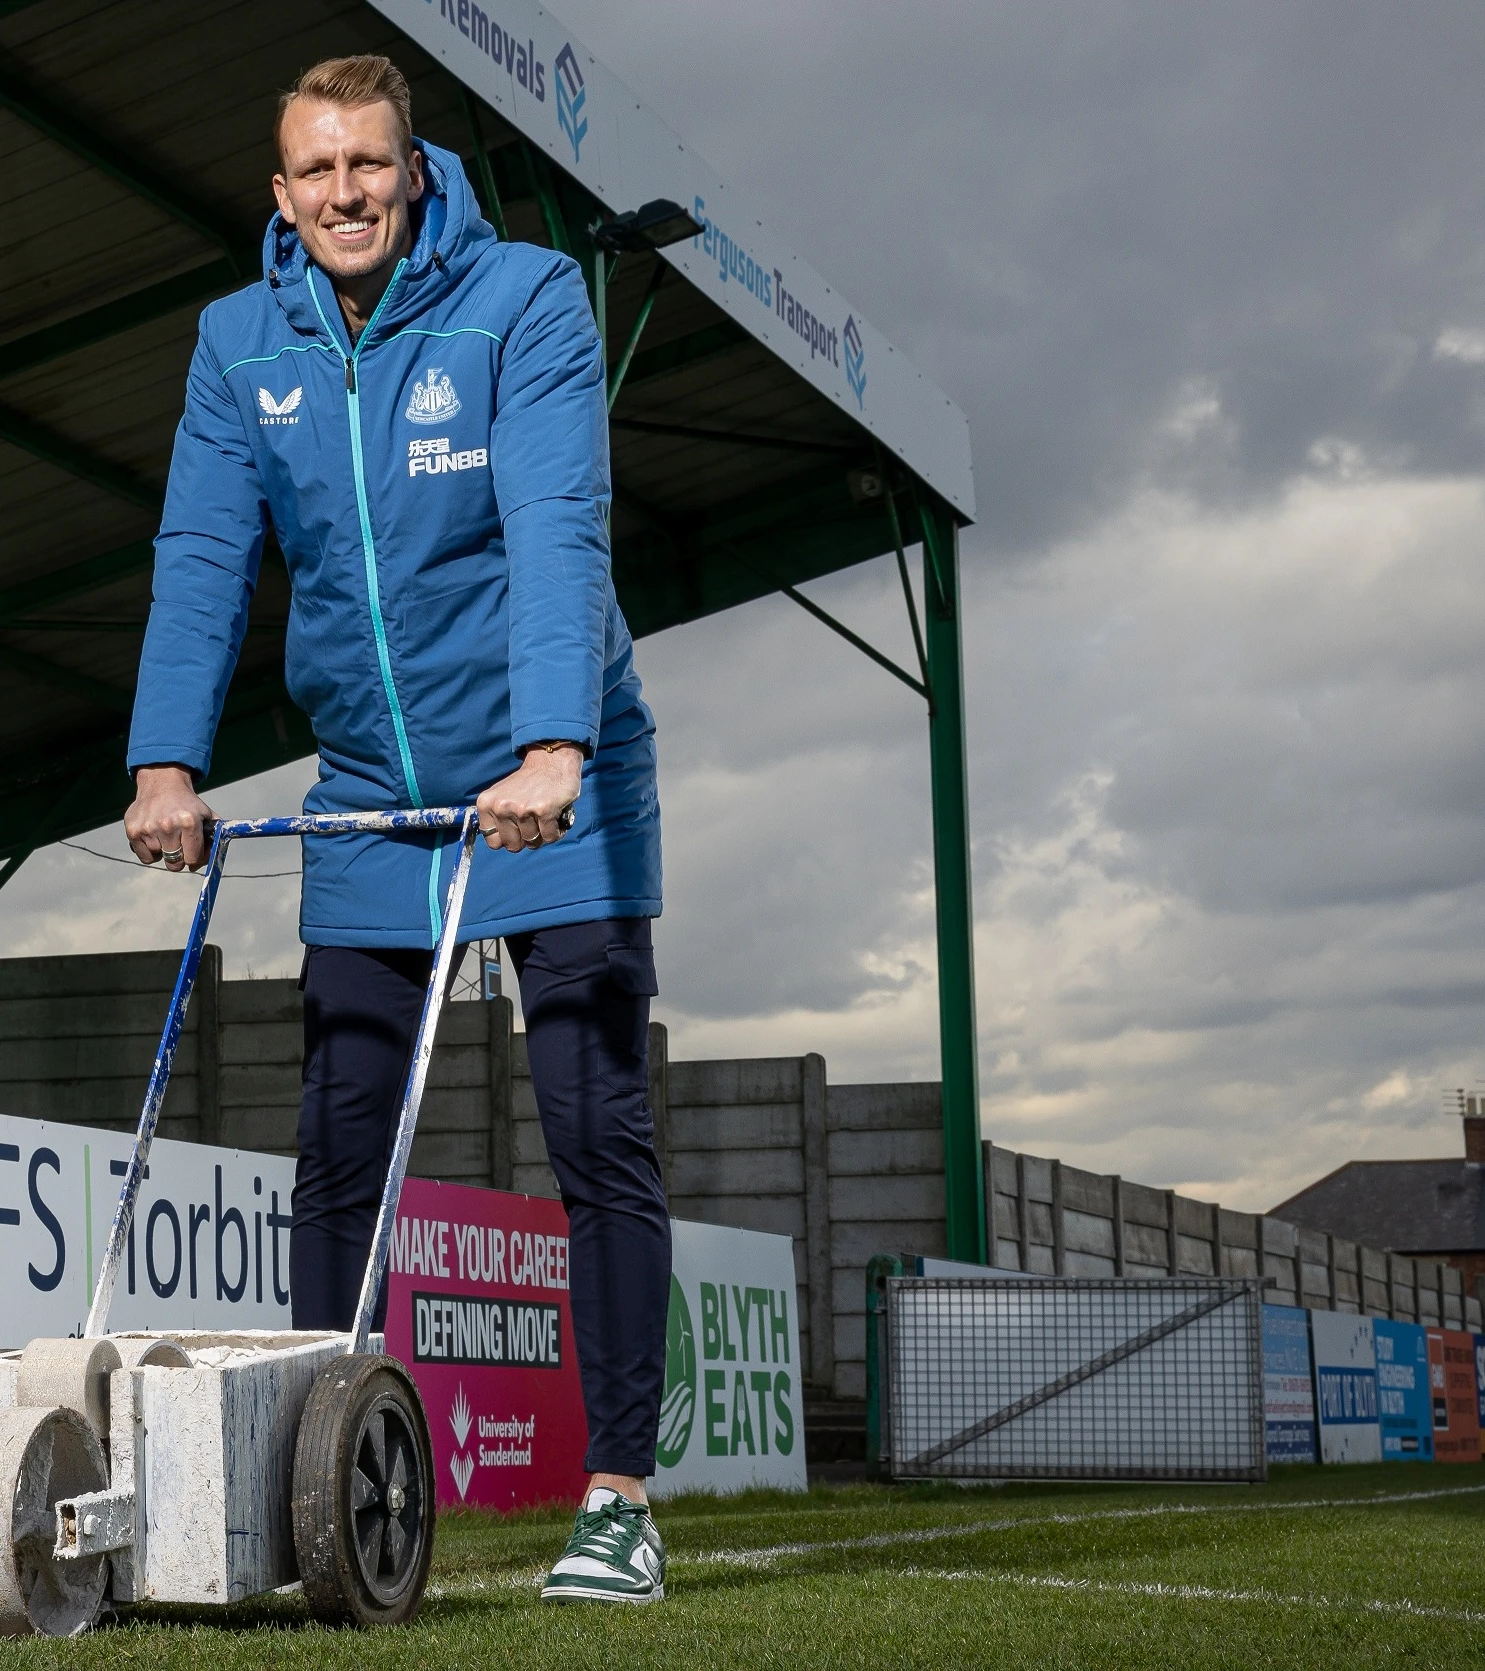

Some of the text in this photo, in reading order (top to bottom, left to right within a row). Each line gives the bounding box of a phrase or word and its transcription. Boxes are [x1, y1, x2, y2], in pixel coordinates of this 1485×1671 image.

[694, 195, 839, 368] Fergusons Transport
[259, 416, 299, 425] CASTORE
[408, 437, 450, 457] 乐天堂
[409, 448, 487, 477] FUN88
[390, 1216, 569, 1290] MAKE YOUR CAREE
[416, 1298, 559, 1363] DEFINING MOVE
[700, 1281, 790, 1364] BLYTH
[478, 1414, 535, 1444] University of
[704, 1369, 794, 1457] EATS
[479, 1442, 531, 1467] Sunderland
